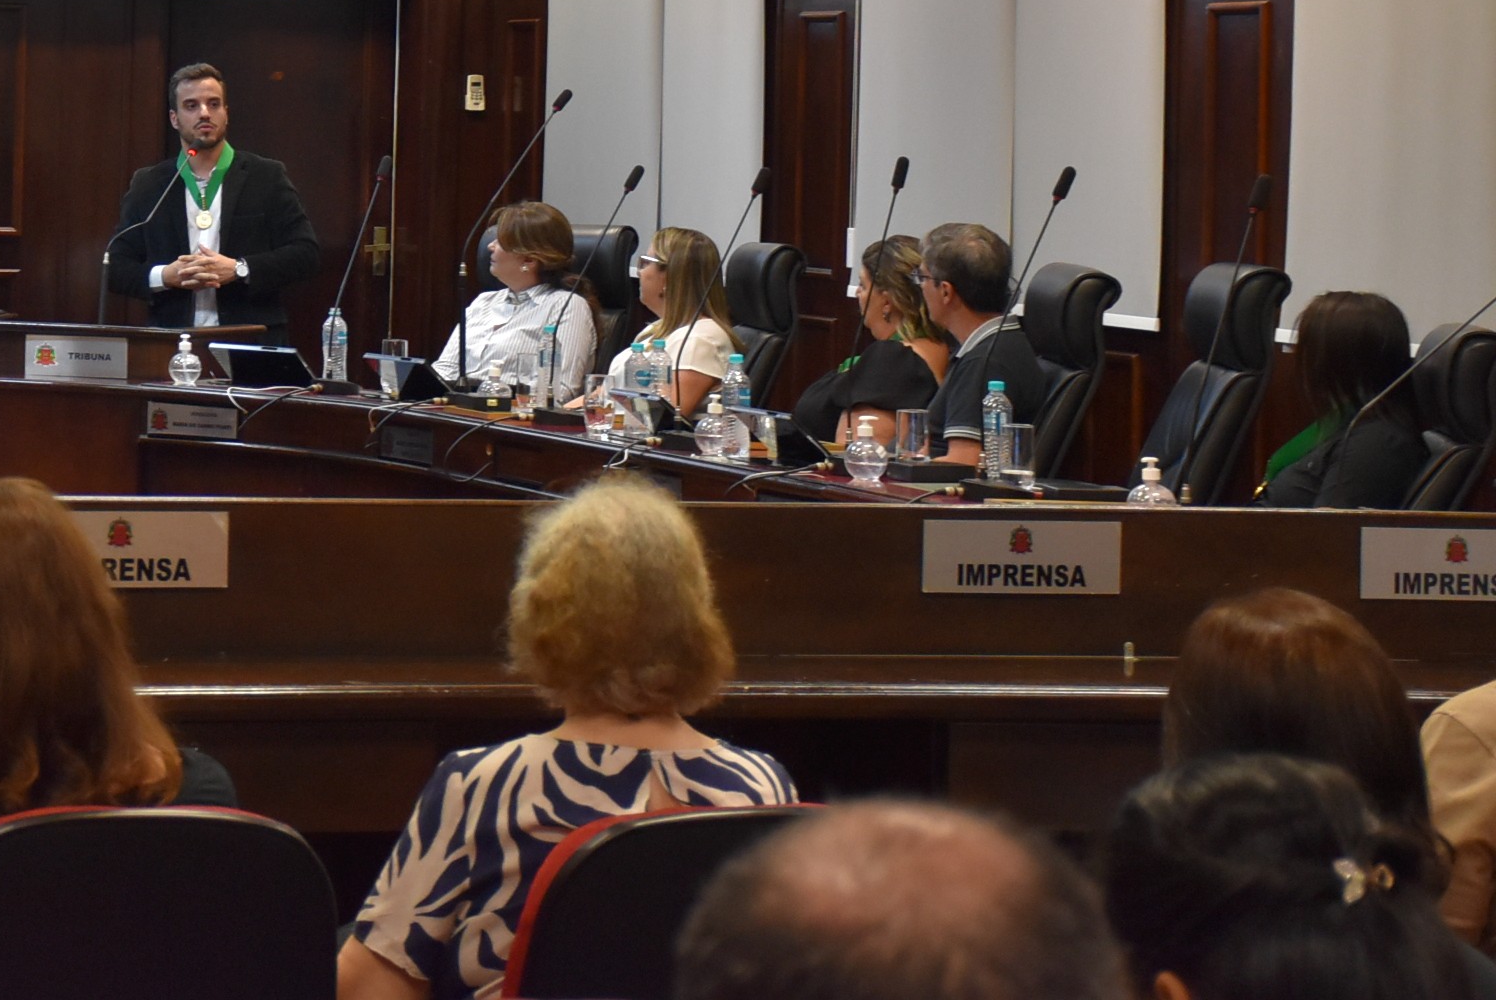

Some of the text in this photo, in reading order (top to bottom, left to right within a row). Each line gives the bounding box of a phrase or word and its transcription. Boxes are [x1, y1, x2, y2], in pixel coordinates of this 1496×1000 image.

[68, 352, 112, 361] TRIBUNA
[101, 558, 190, 582] RENSA
[957, 563, 1086, 588] IMPRENSA
